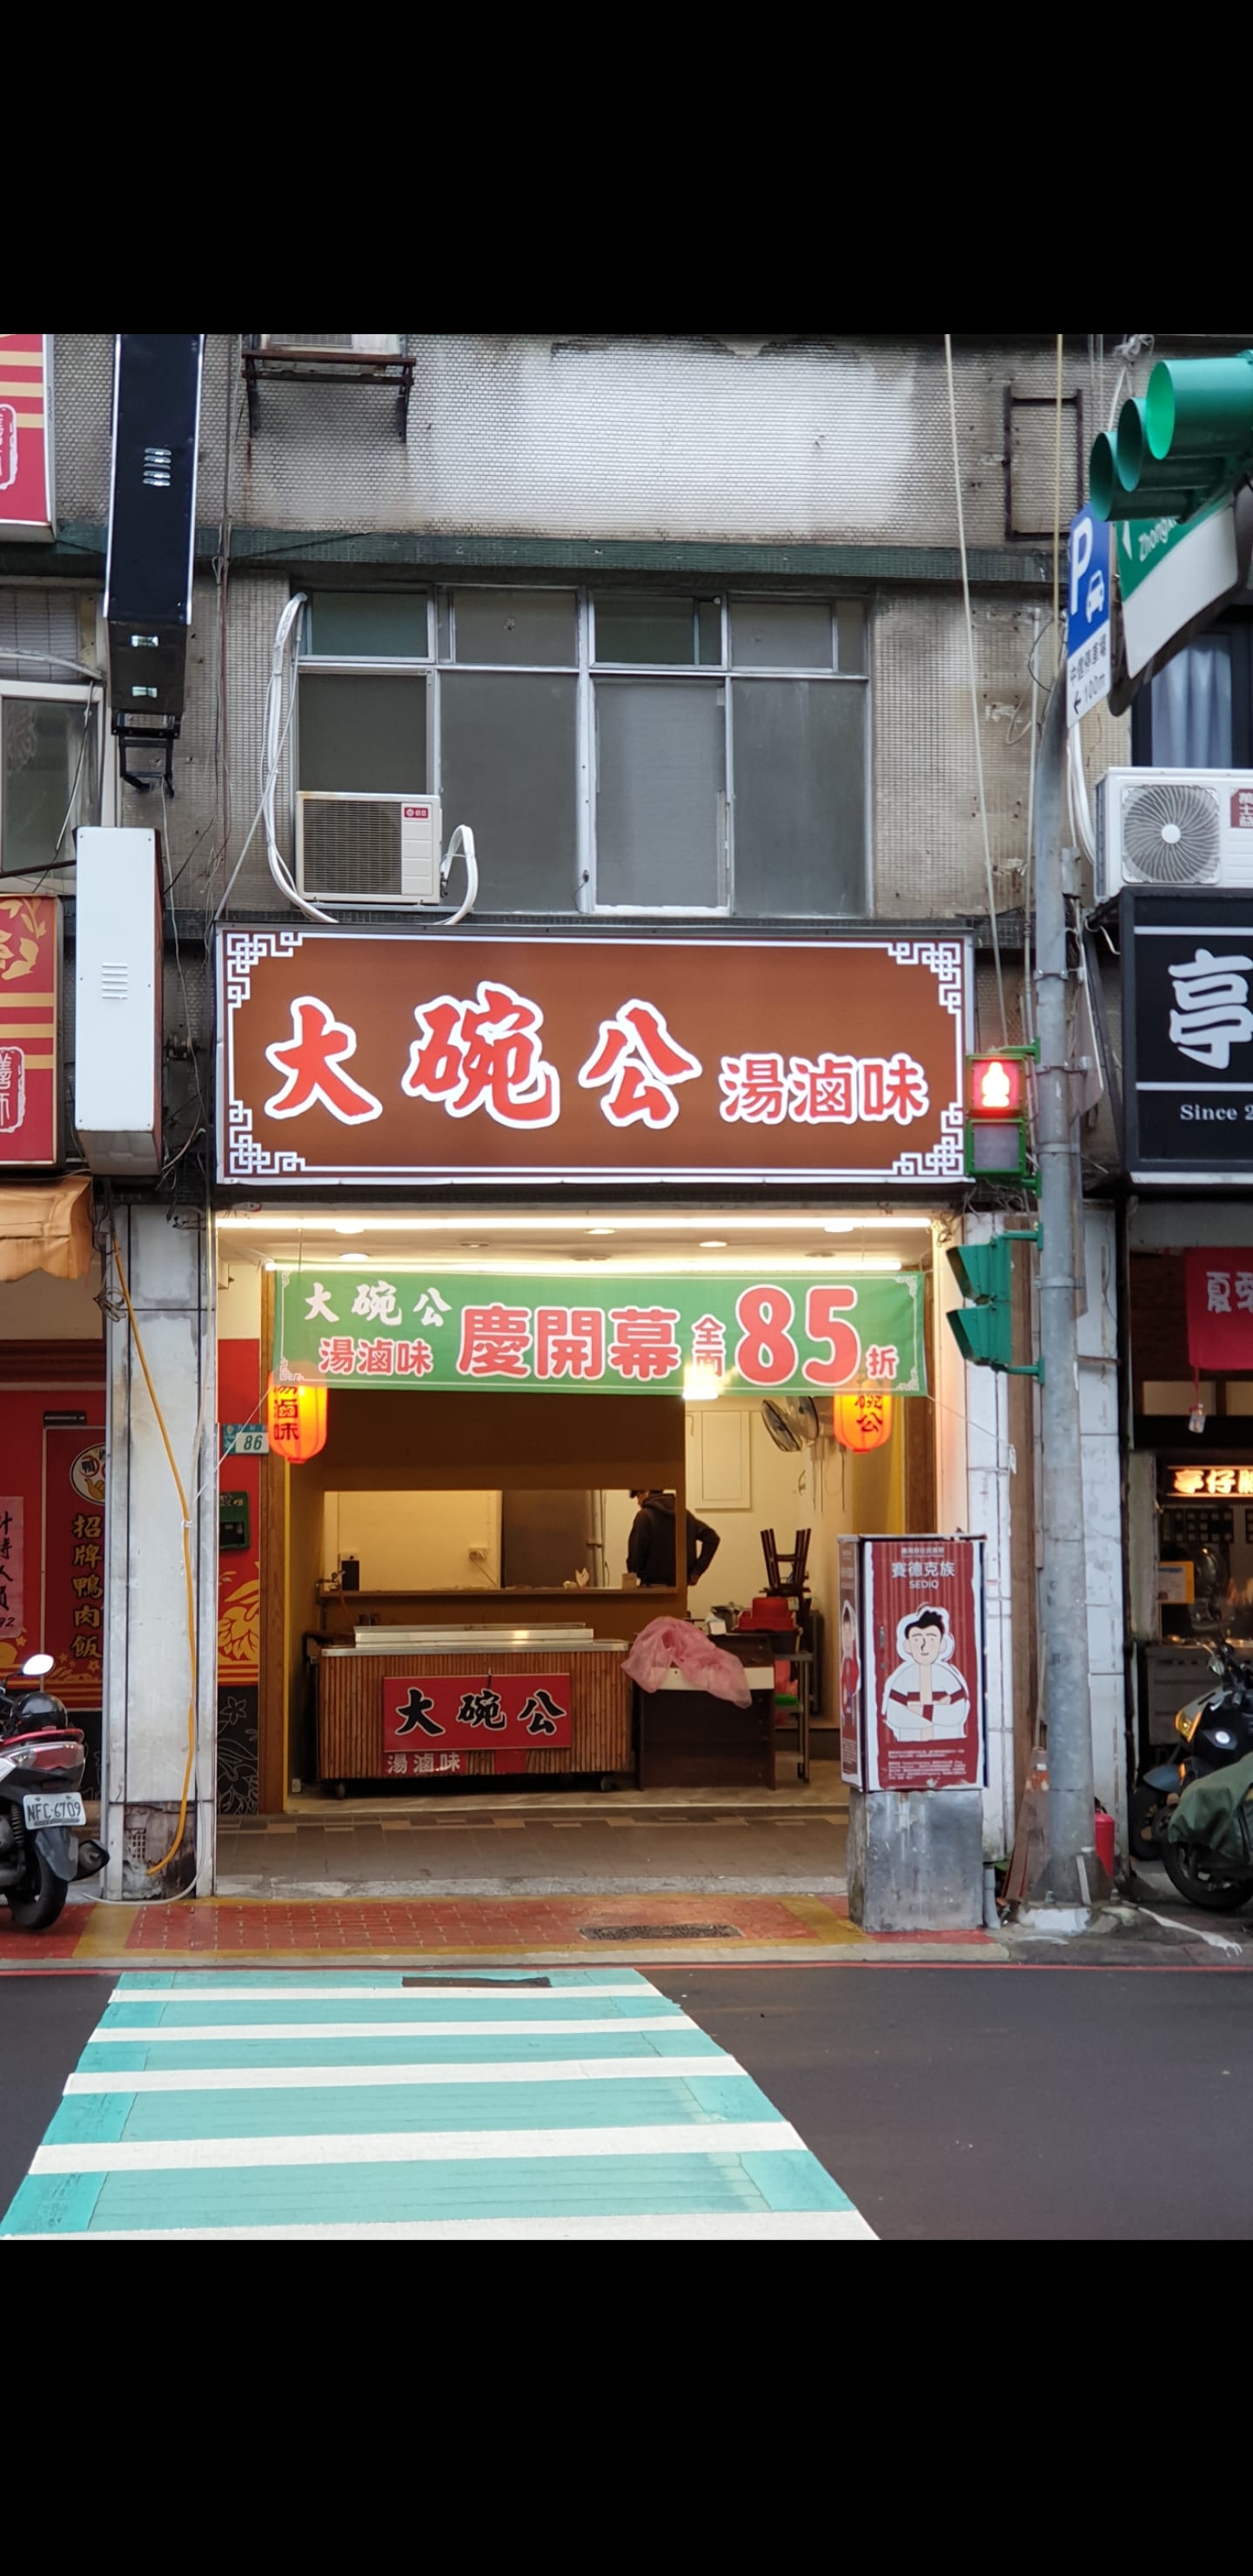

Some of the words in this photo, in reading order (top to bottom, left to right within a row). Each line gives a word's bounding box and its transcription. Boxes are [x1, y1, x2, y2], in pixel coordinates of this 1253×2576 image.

[1071, 517, 1093, 616] P
[1168, 948, 1253, 1070] 亭
[265, 981, 702, 1128] 大碗公
[719, 1053, 928, 1124] 湯滷味
[1180, 1103, 1237, 1121] Since
[305, 1281, 451, 1326] 大碗公
[456, 1304, 680, 1381] 慶開幕
[318, 1338, 433, 1375] 湯滷味
[244, 1435, 263, 1450] 86
[71, 1514, 103, 1660] 招牌鴨肉飯
[891, 1560, 955, 1579] 賽德克族
[909, 1580, 939, 1589] SEDIQ
[395, 1687, 567, 1737] 大碗公
[387, 1754, 461, 1774] 湯滷味
